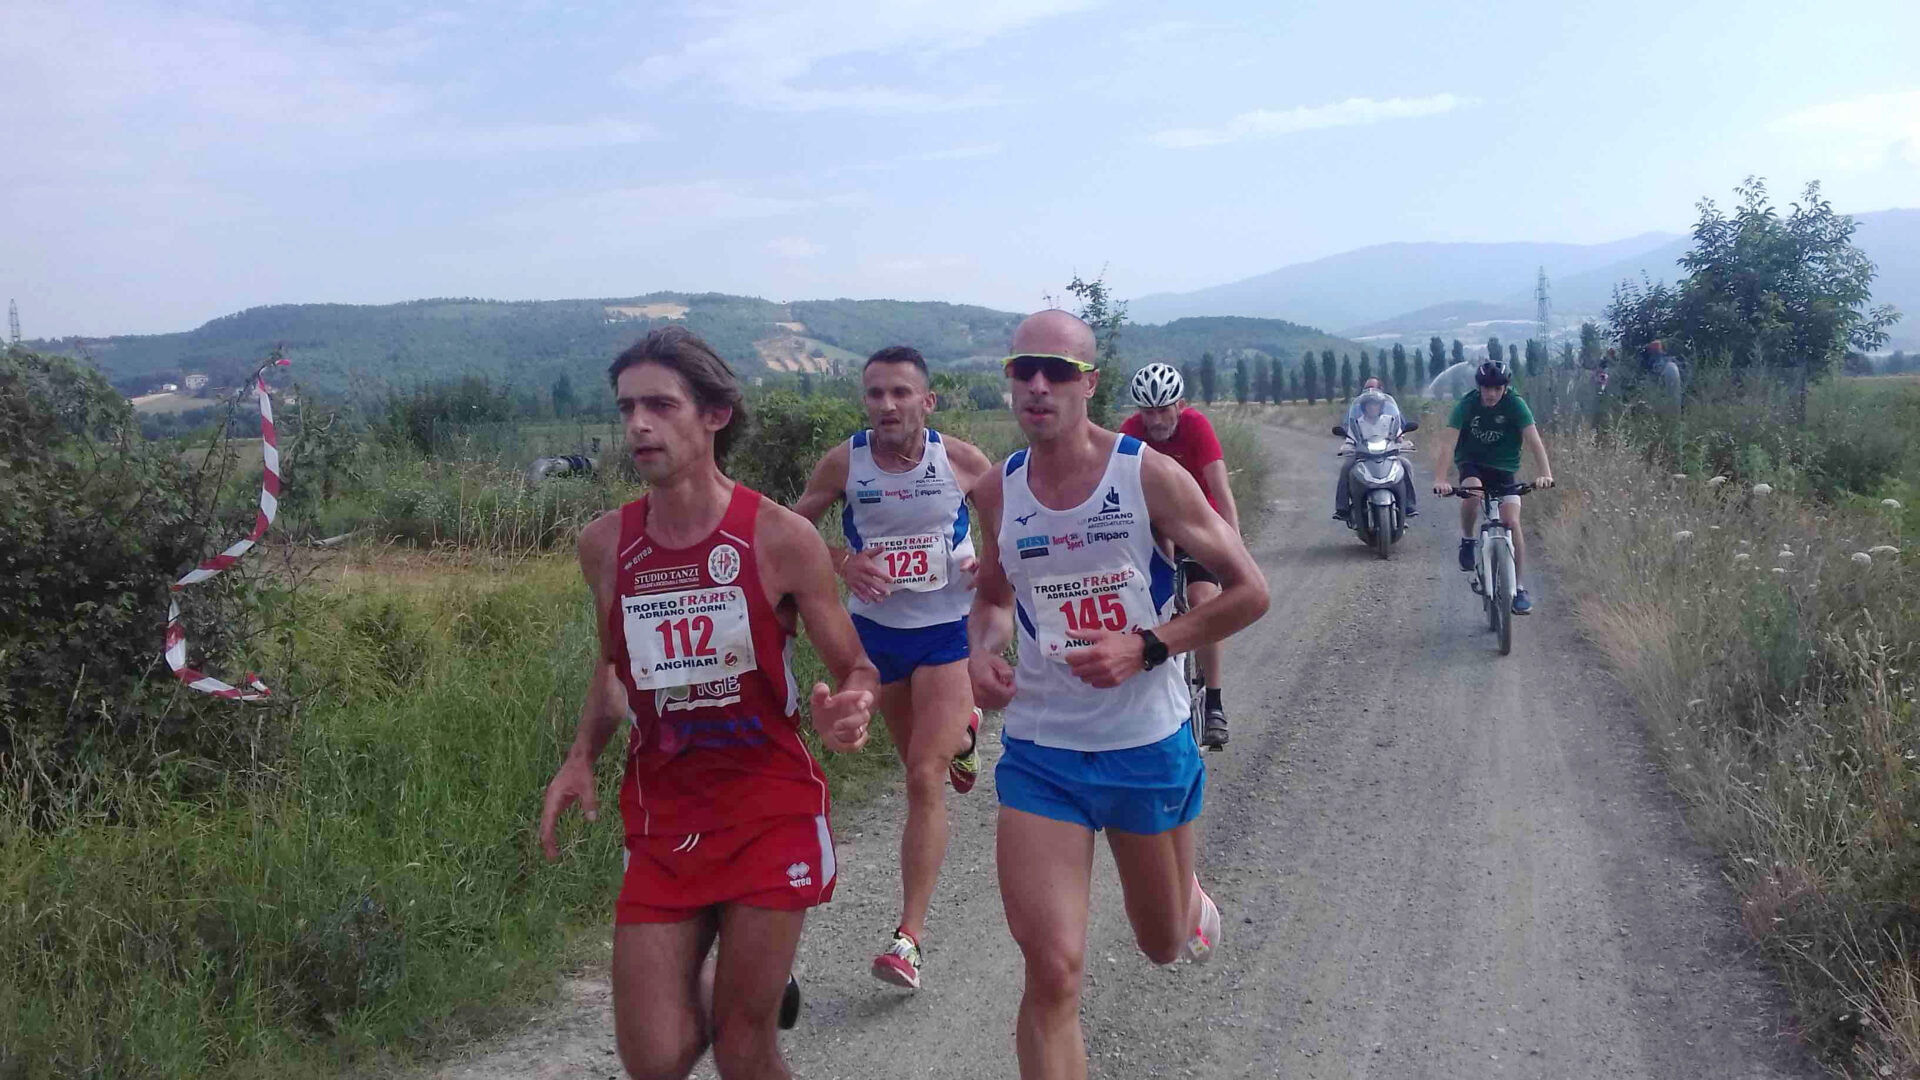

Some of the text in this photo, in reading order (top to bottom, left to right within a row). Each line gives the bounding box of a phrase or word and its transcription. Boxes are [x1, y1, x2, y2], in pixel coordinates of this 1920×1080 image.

[1088, 513, 1133, 522] POLICIANO
[884, 550, 928, 577] 123
[634, 572, 668, 585] STUDIO
[670, 568, 698, 579] TANZI
[1034, 581, 1081, 594] TROFEO
[1047, 581, 1128, 600] ADRIANO GIORNI
[626, 600, 677, 614] TROFEO
[638, 603, 726, 620] ADRIANO GIORNI
[1059, 593, 1127, 631] 145
[656, 615, 716, 660] 112
[655, 657, 718, 672] ANGHIARI
